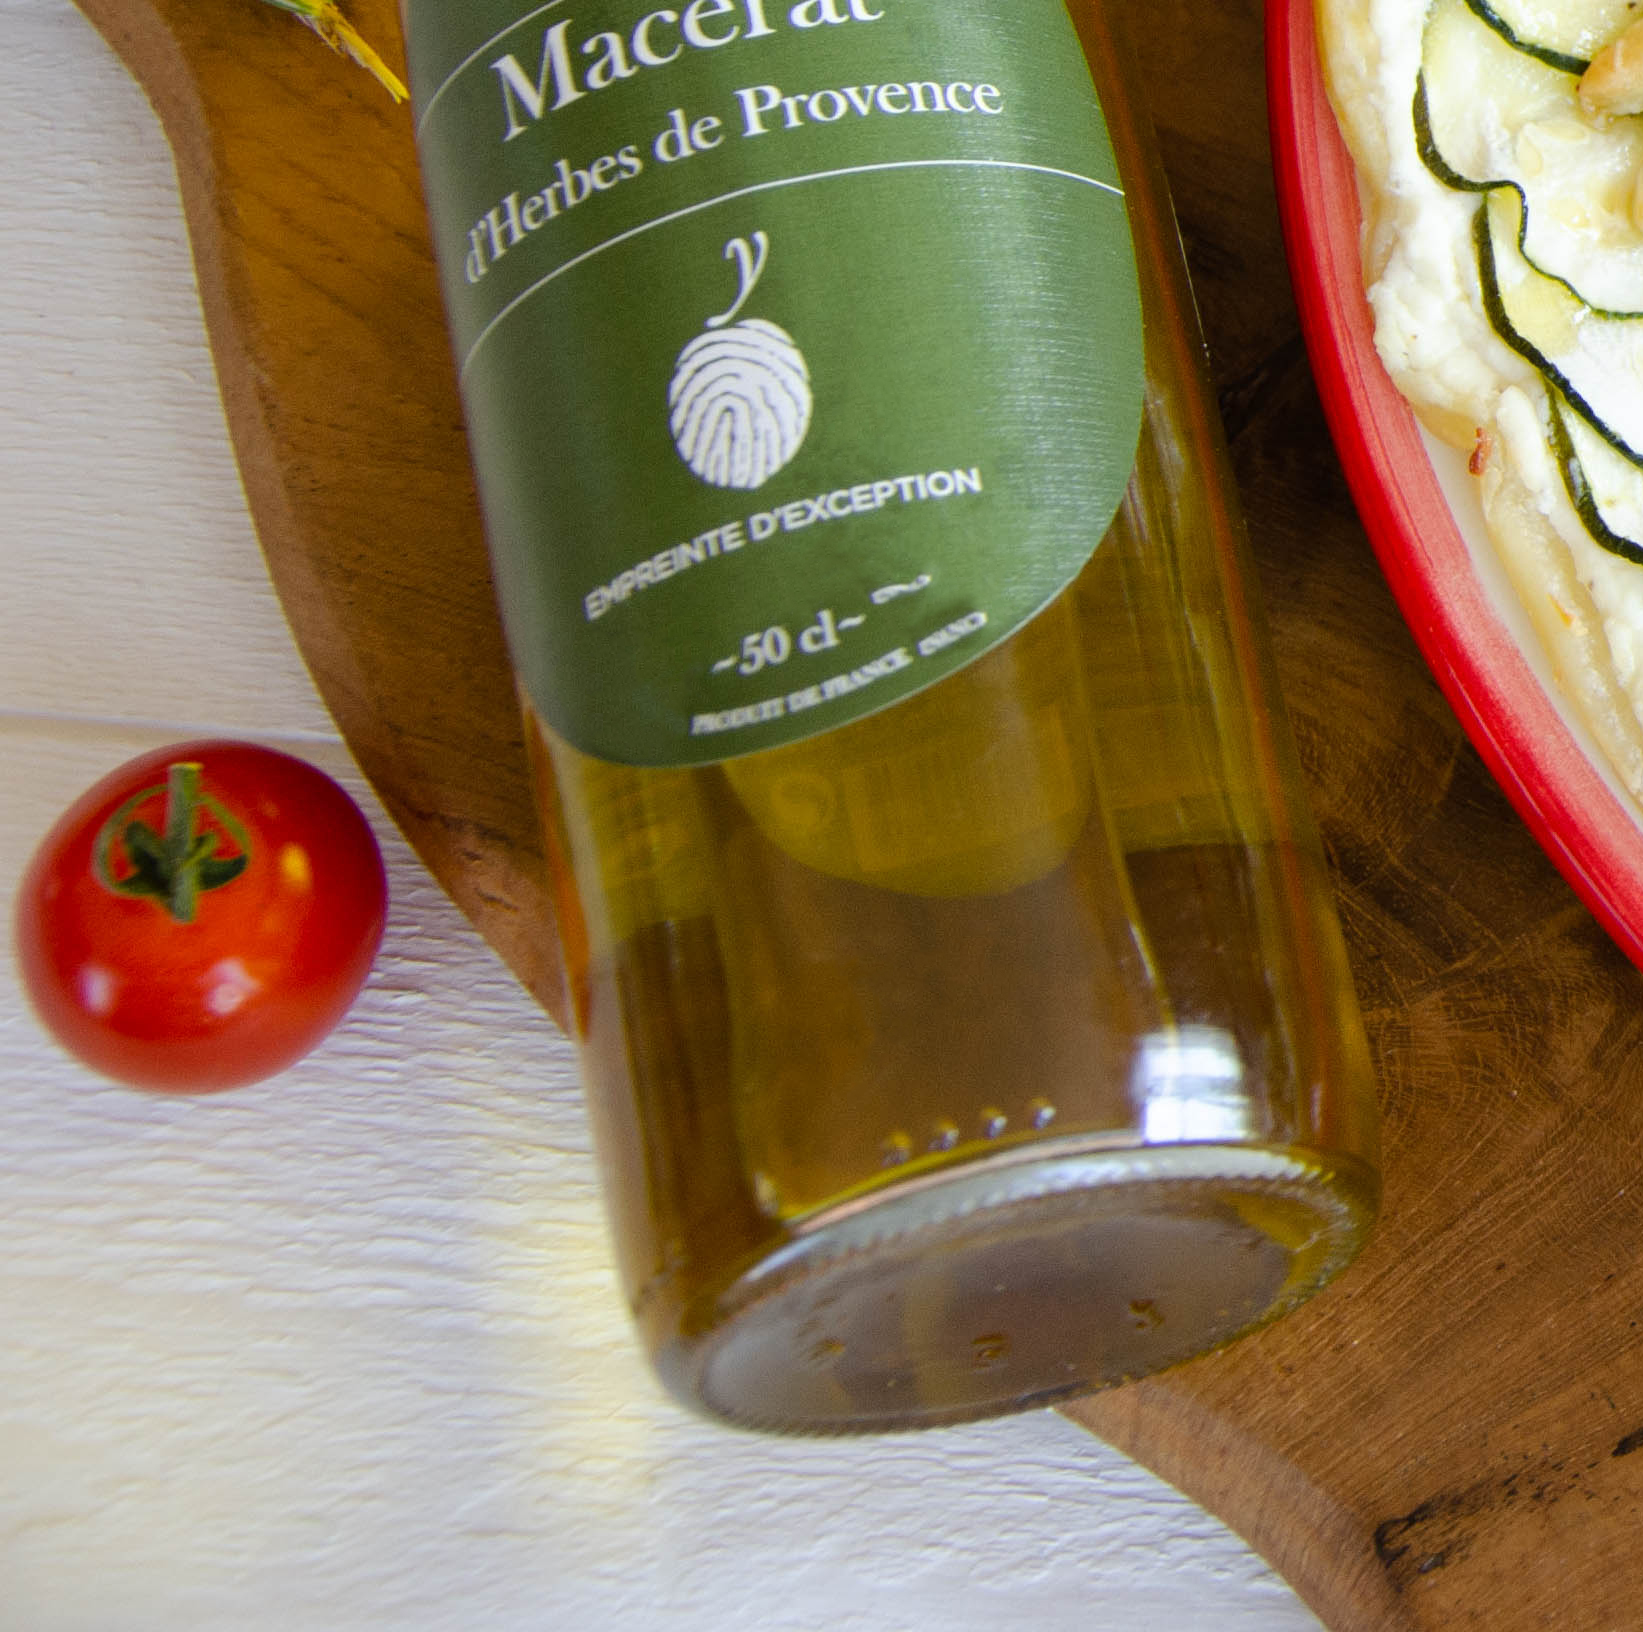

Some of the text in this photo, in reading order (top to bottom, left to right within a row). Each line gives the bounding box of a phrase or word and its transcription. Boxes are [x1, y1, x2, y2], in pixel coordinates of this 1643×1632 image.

[464, 79, 1005, 284] d'Herbes de Provence
[583, 468, 983, 622] EMPREINTE D'EXCEPTION
